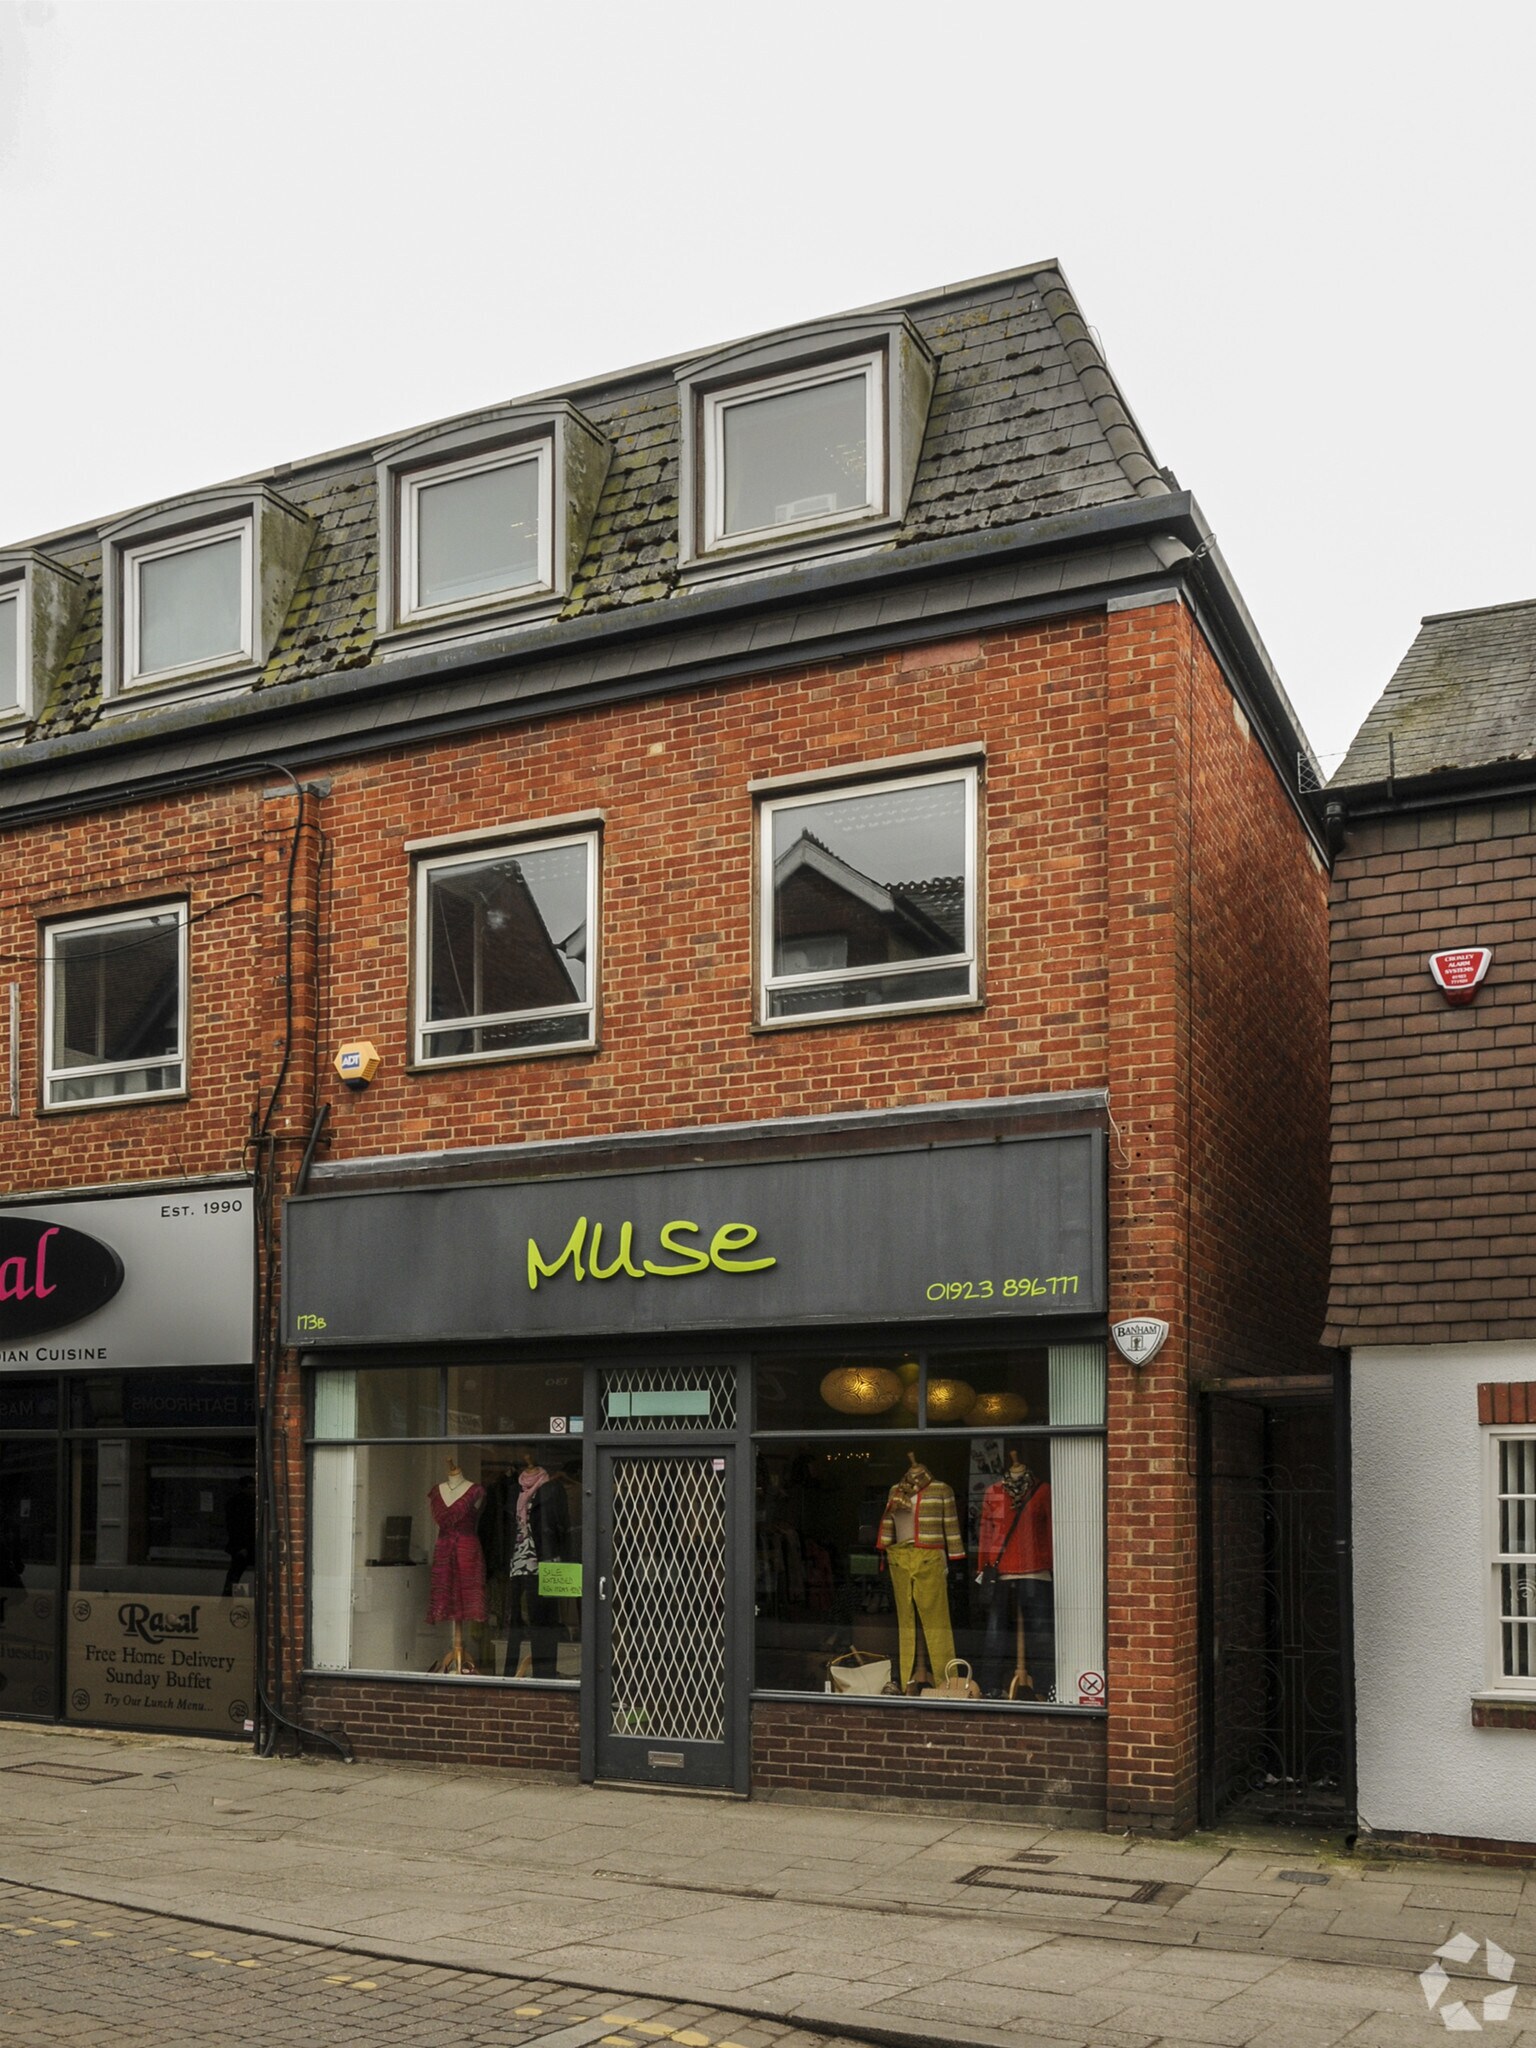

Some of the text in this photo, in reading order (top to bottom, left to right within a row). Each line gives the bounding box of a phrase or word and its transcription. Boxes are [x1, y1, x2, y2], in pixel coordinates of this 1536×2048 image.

[1444, 966, 1474, 974] SYSTEMS
[1448, 960, 1471, 968] ALARM
[342, 1055, 360, 1066] ADT
[203, 1200, 243, 1214] 1990
[926, 1275, 1079, 1301] 01923 896777
[1117, 1325, 1157, 1337] BANHAM
[0, 1350, 28, 1362] IAN
[85, 1645, 235, 1673] Free Home Delivery
[106, 1667, 212, 1690] Sunday Buffet
[104, 1693, 121, 1707] Try
[123, 1695, 141, 1706] Our
[144, 1696, 174, 1710] Lunch
